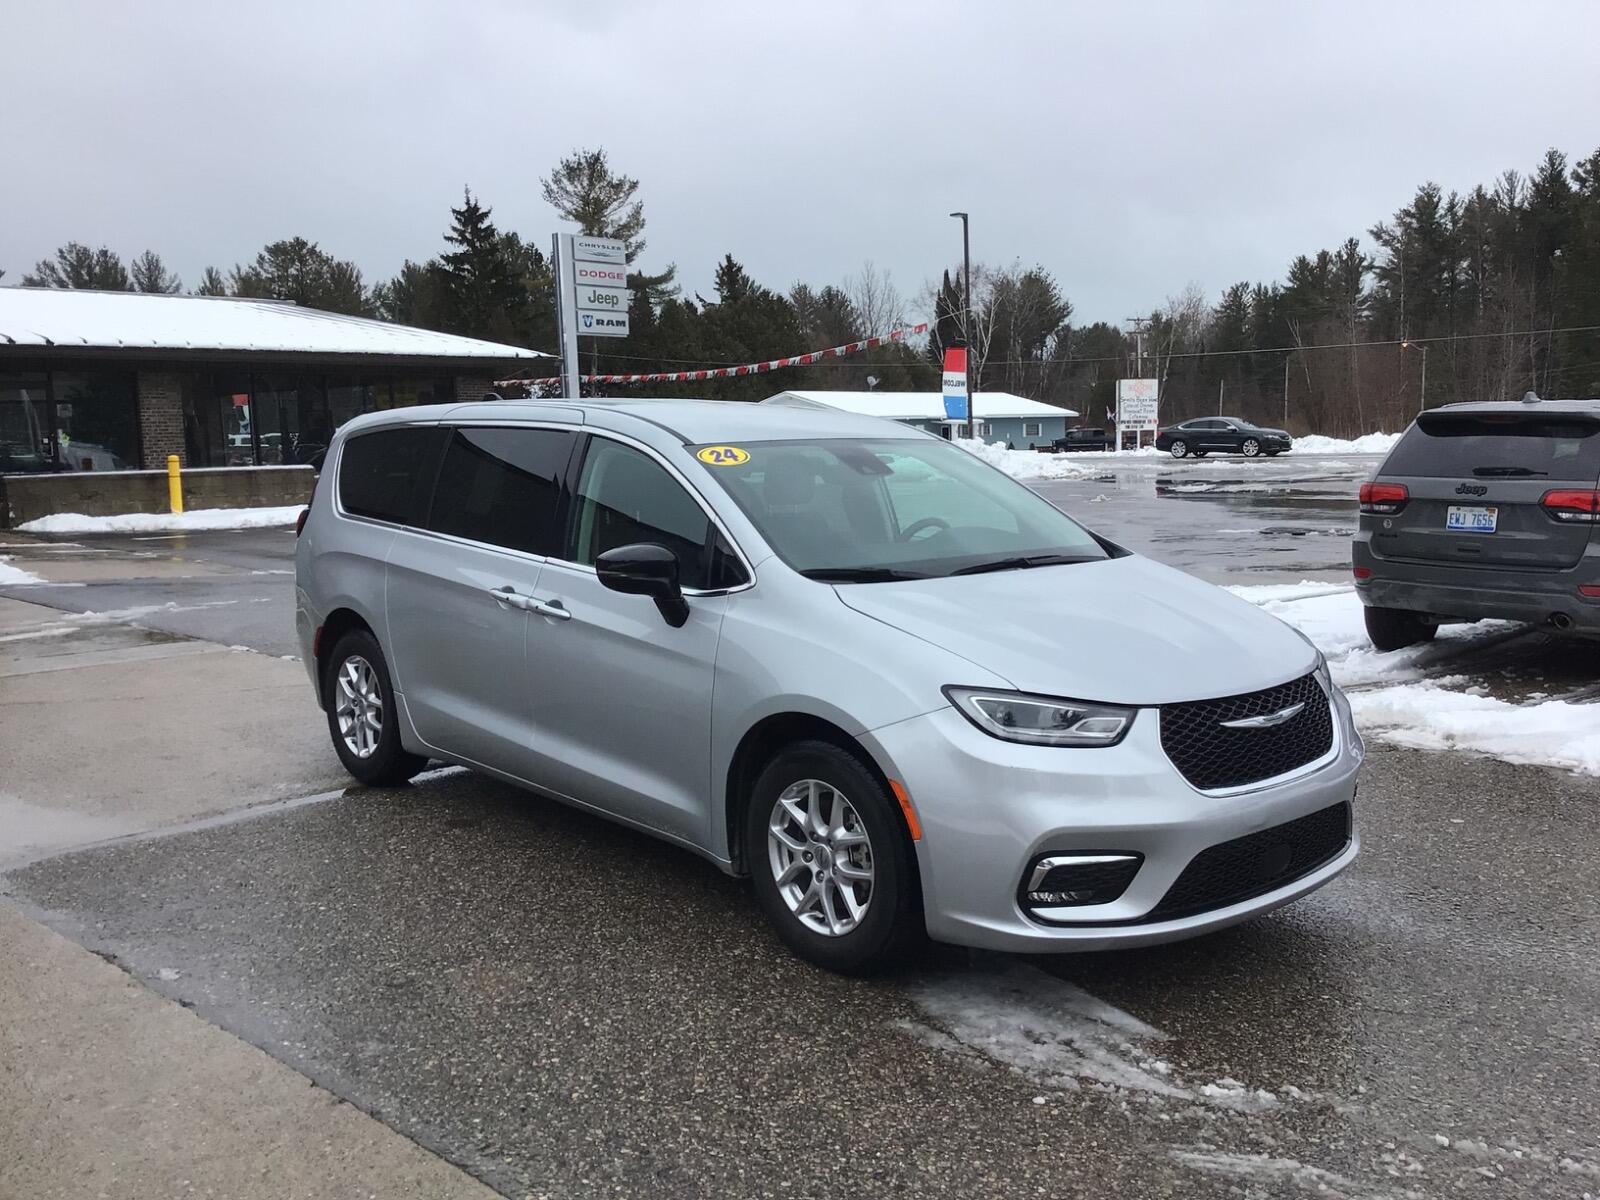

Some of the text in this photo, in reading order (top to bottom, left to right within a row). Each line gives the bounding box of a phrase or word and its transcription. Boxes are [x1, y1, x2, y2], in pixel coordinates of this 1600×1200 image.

[579, 242, 621, 251] CHRYSLER
[579, 269, 624, 280] DODGE
[588, 289, 619, 308] Jeep
[596, 318, 626, 327] RAM
[709, 449, 739, 463] 24
[1455, 483, 1488, 497] Jeep
[1449, 512, 1494, 526] EWJ 7656
